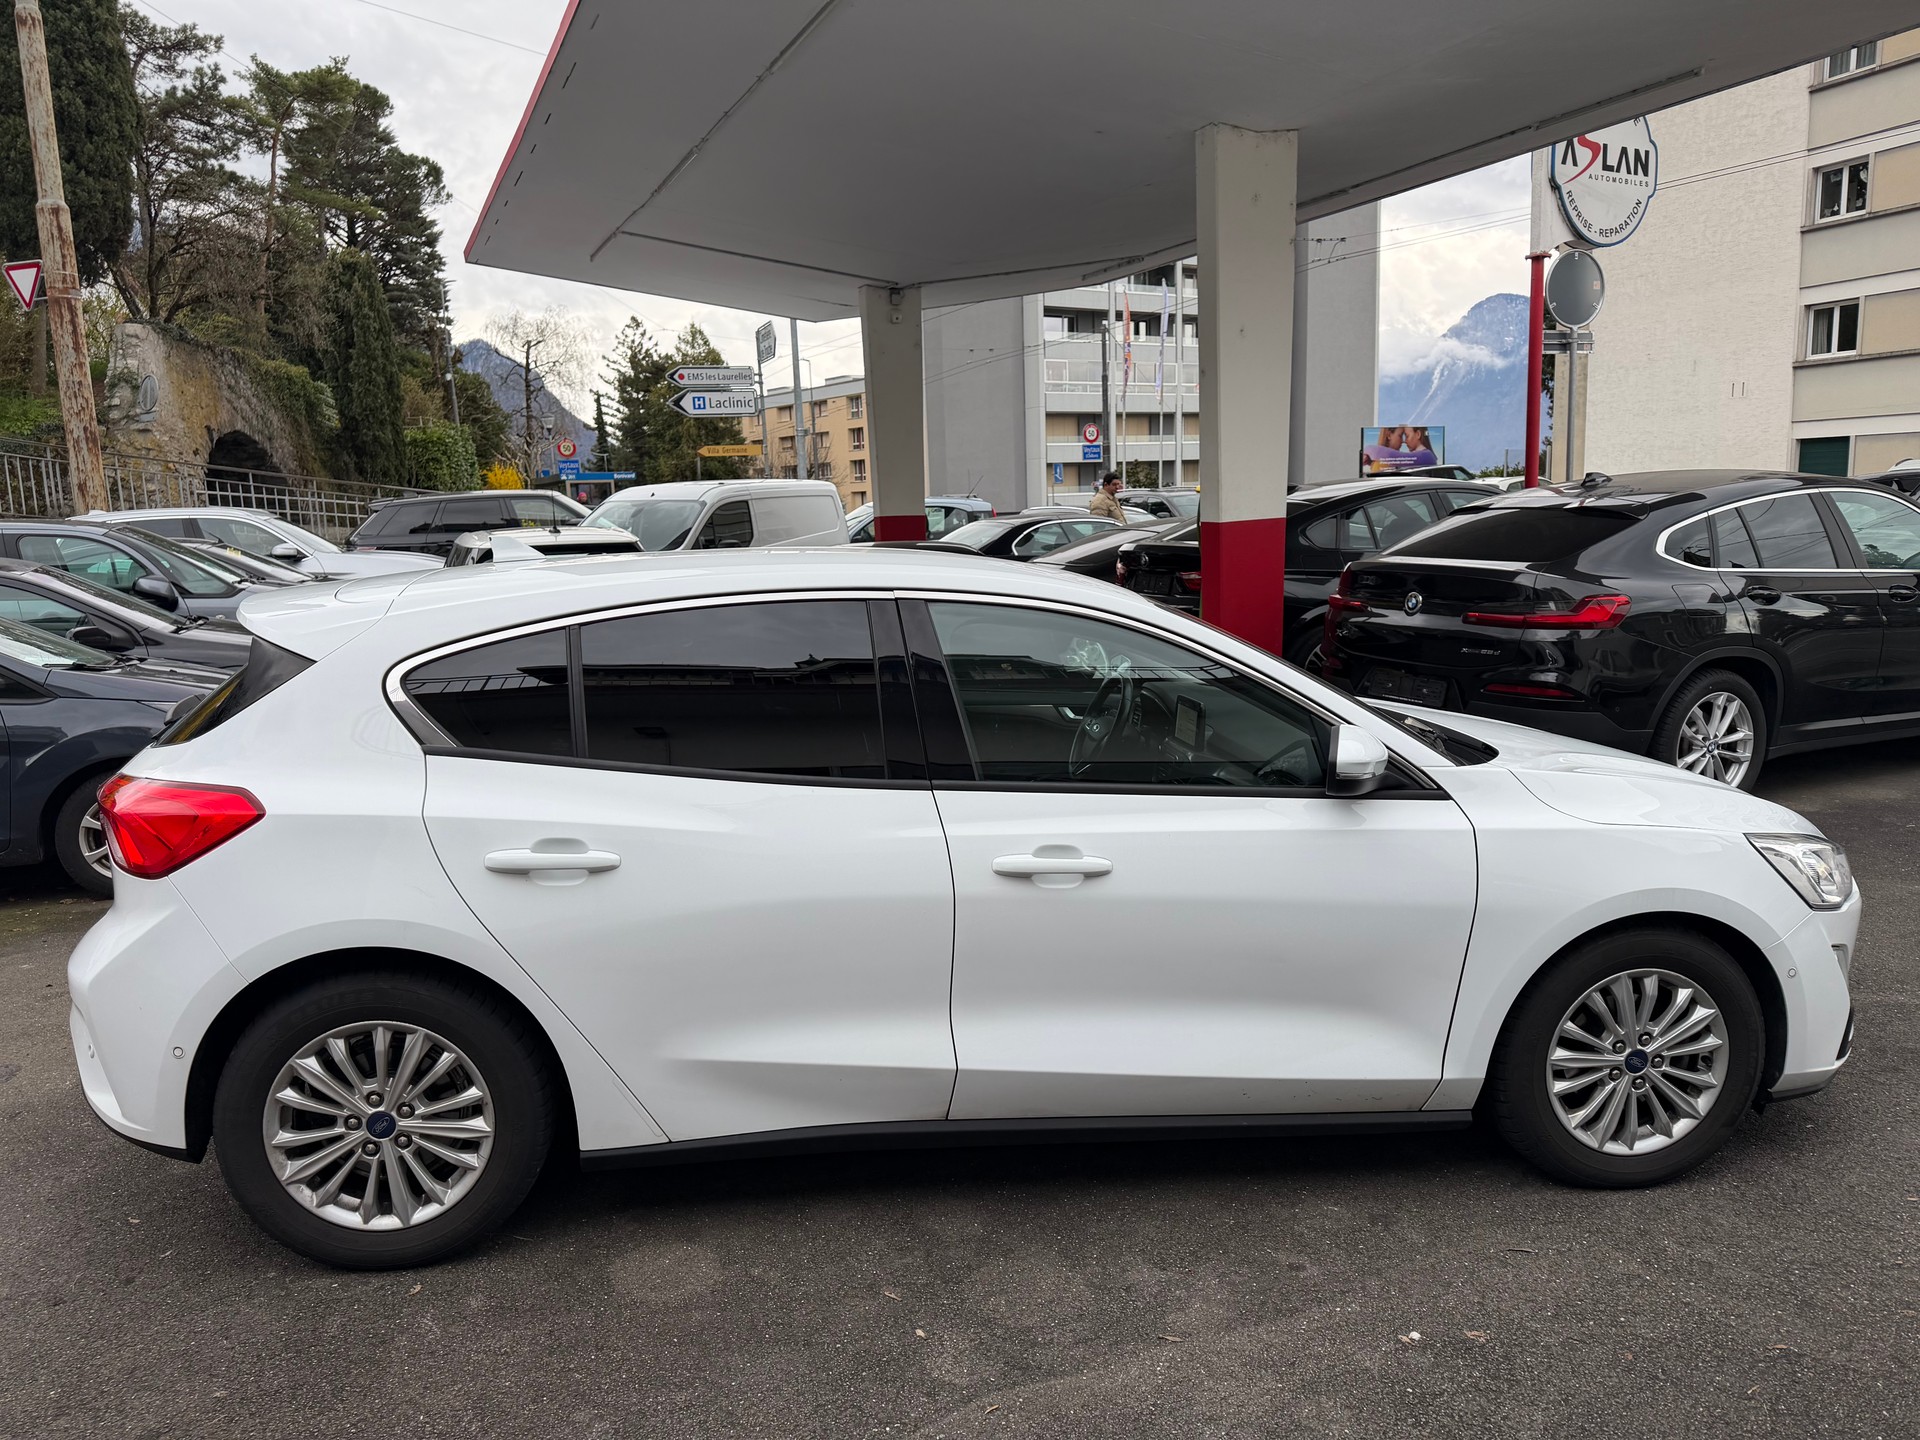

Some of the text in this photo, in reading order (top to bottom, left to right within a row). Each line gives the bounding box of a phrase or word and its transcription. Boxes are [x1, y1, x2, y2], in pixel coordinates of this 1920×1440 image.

[1561, 135, 1650, 185] ASLAN
[1588, 173, 1649, 188] AUTOMOBILES
[1566, 190, 1593, 233] REPRISE
[1598, 198, 1643, 238] REPARATION
[687, 372, 752, 381] EMS les Laurelles
[708, 396, 754, 409] Laclinic
[1088, 429, 1095, 437] 50
[562, 444, 572, 452] 50
[706, 446, 748, 455] Villa Germaine
